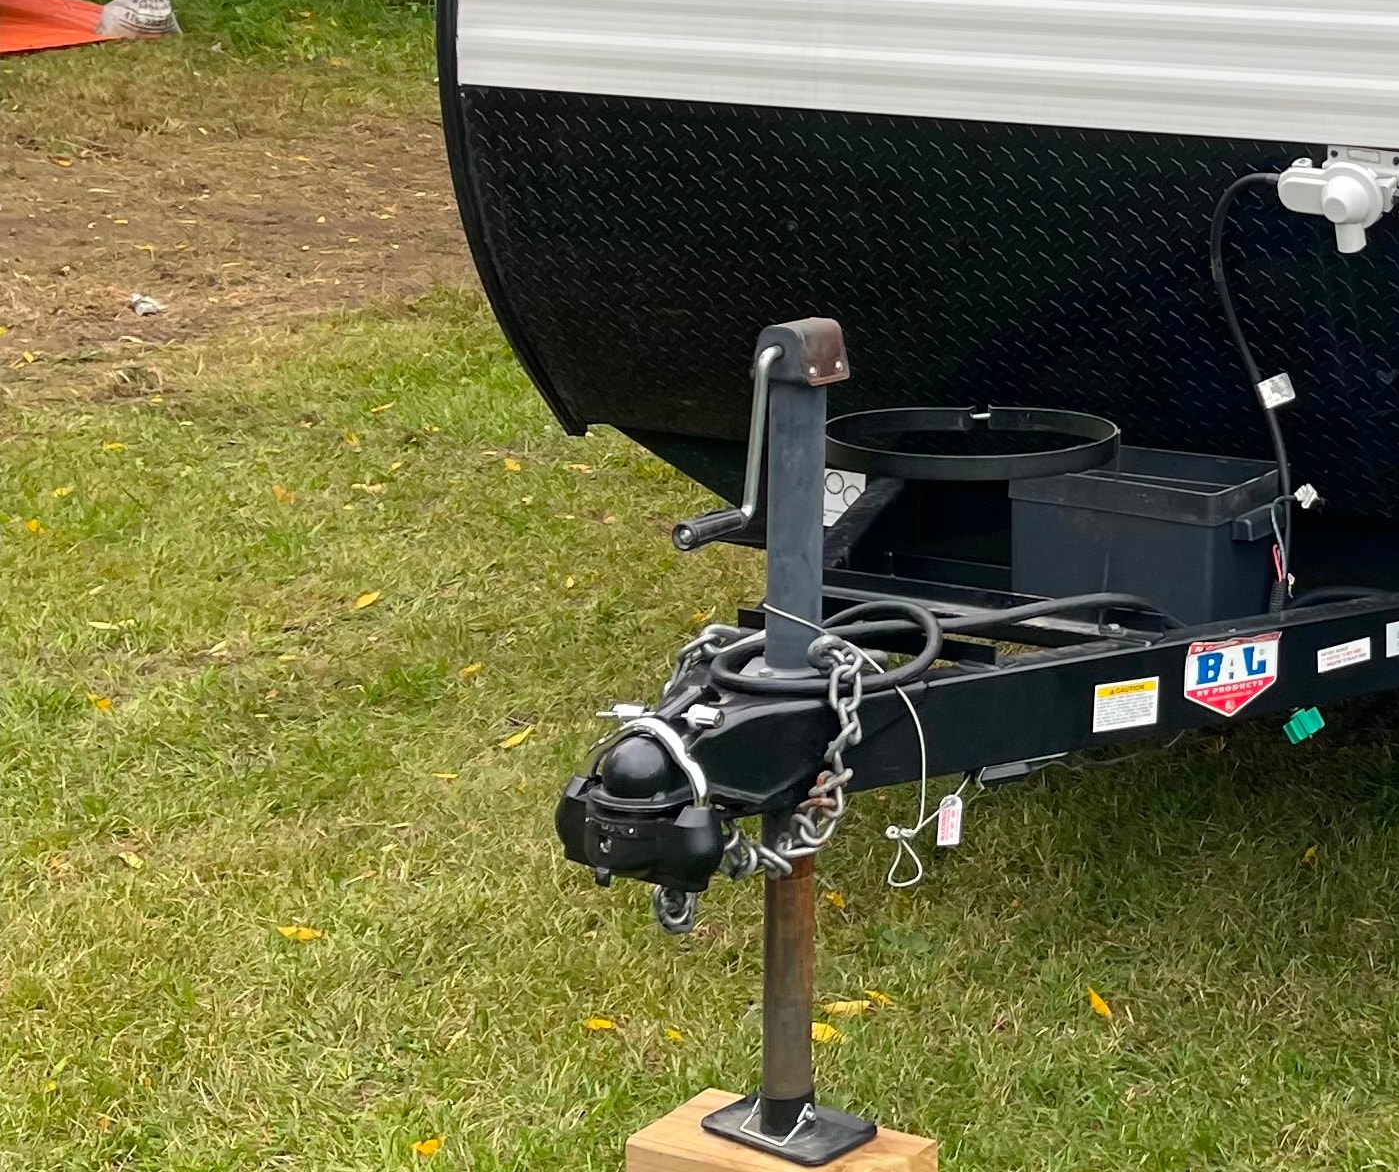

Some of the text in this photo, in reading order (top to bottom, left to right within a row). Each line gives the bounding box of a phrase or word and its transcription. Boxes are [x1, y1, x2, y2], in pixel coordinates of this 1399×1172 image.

[1196, 645, 1267, 686] BAL
[1115, 683, 1145, 695] CAUTION
[1212, 679, 1264, 695] PRODUCTS
